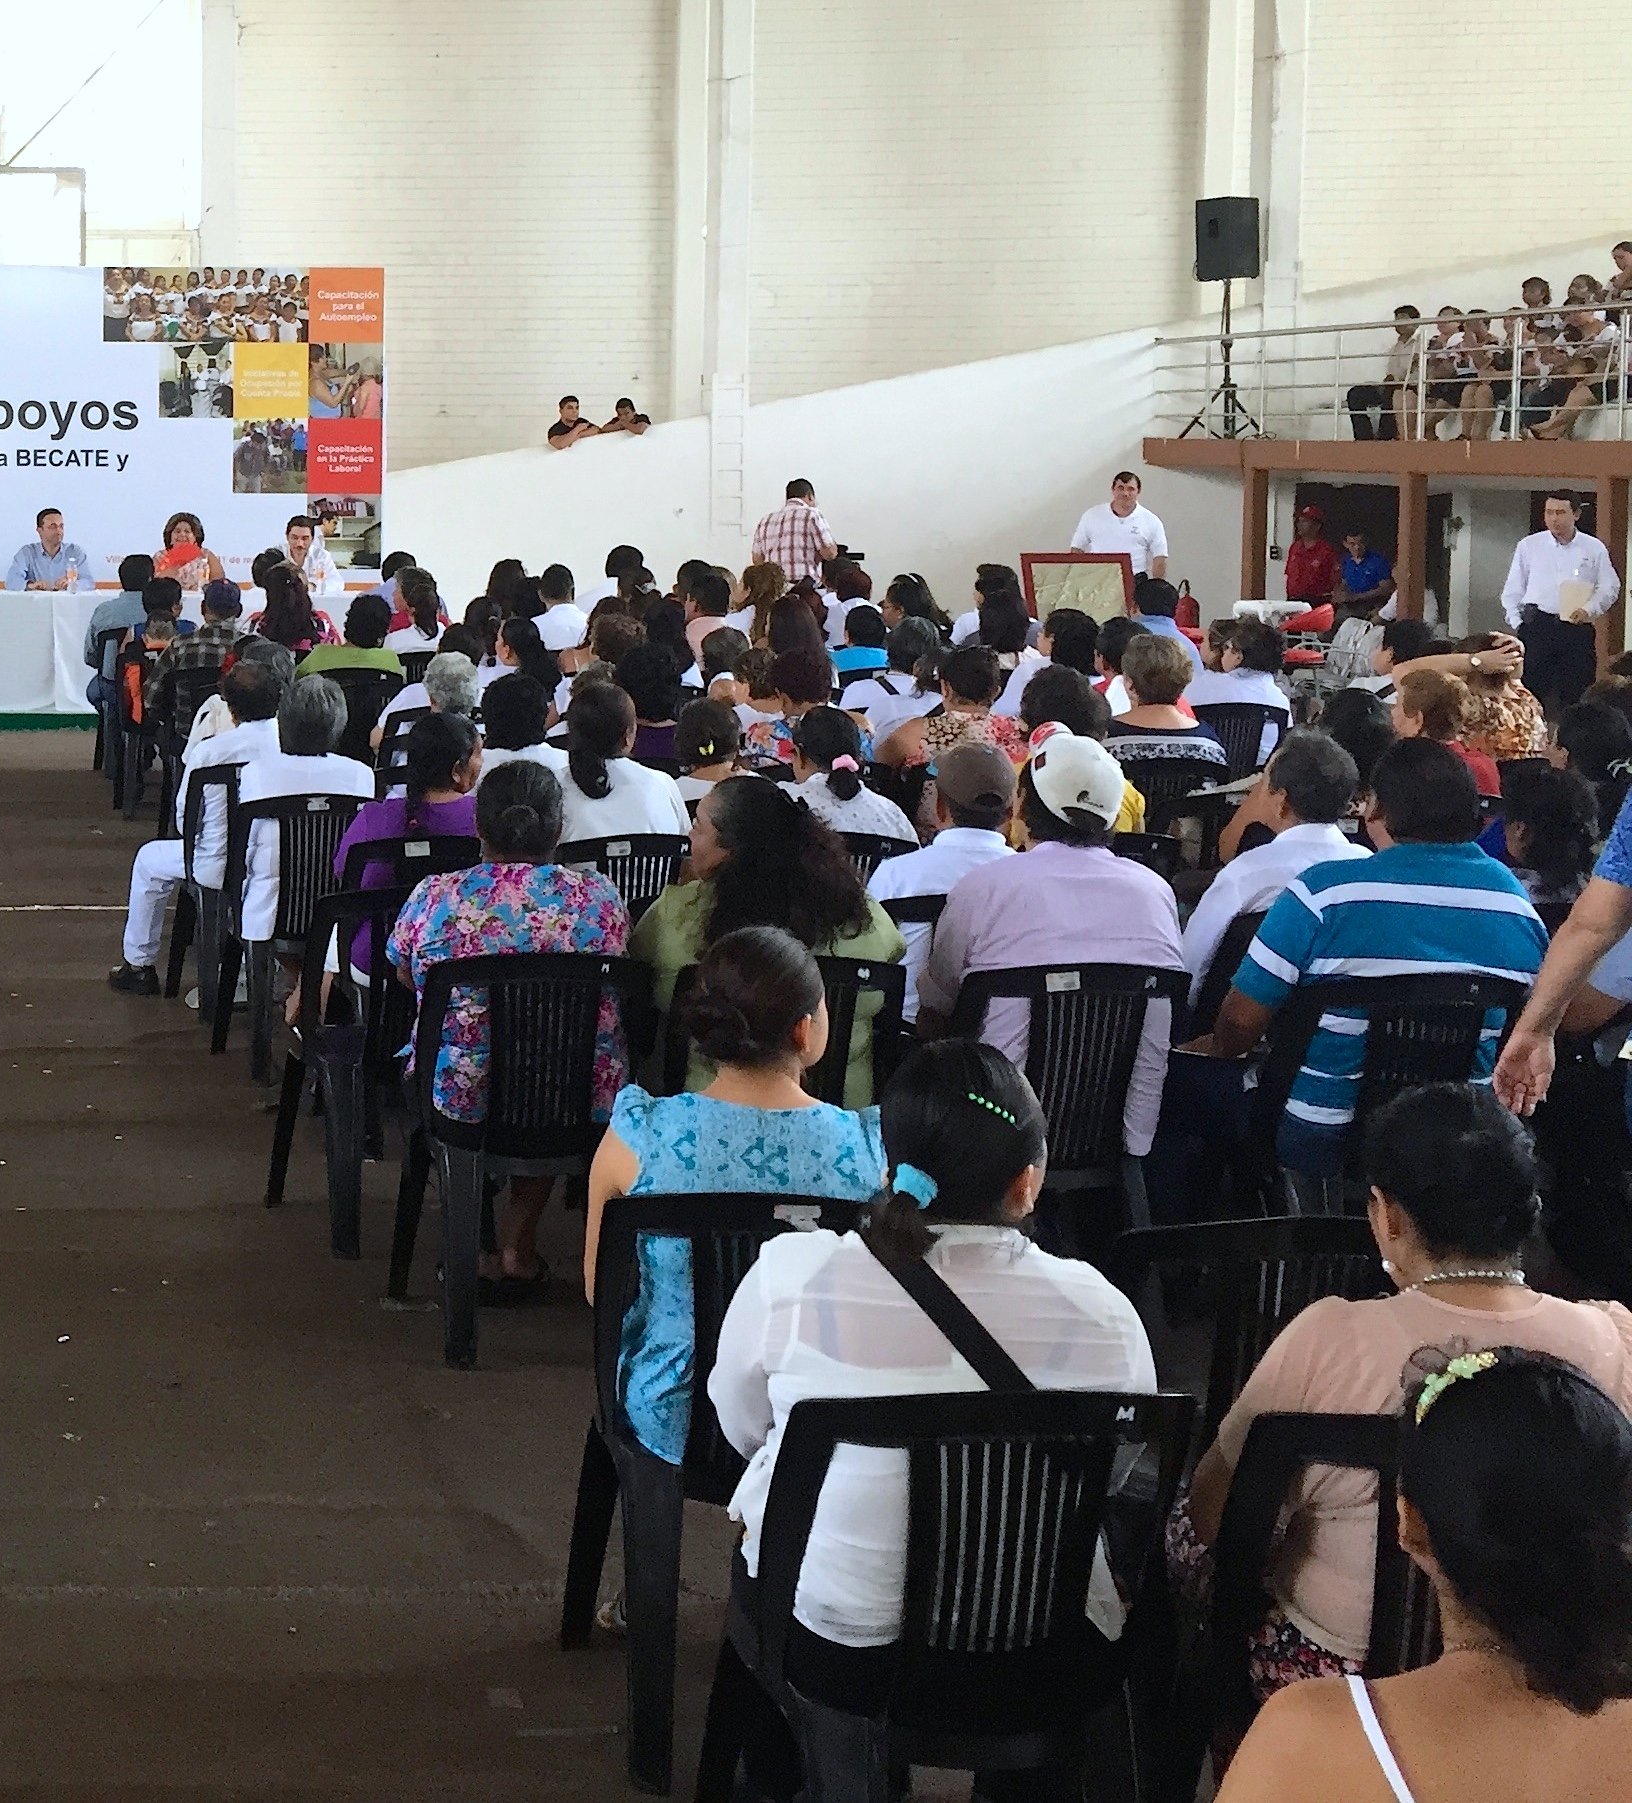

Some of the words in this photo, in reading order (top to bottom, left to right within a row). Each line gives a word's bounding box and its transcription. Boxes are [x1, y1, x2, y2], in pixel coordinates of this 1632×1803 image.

[317, 290, 379, 300] Capacitación
[332, 303, 353, 311] para
[356, 302, 365, 310] el
[319, 312, 377, 322] Autoempleo
[317, 444, 374, 454] Capacitación
[17, 450, 108, 466] BECATE
[117, 455, 128, 471] y
[339, 454, 374, 463] Práctica
